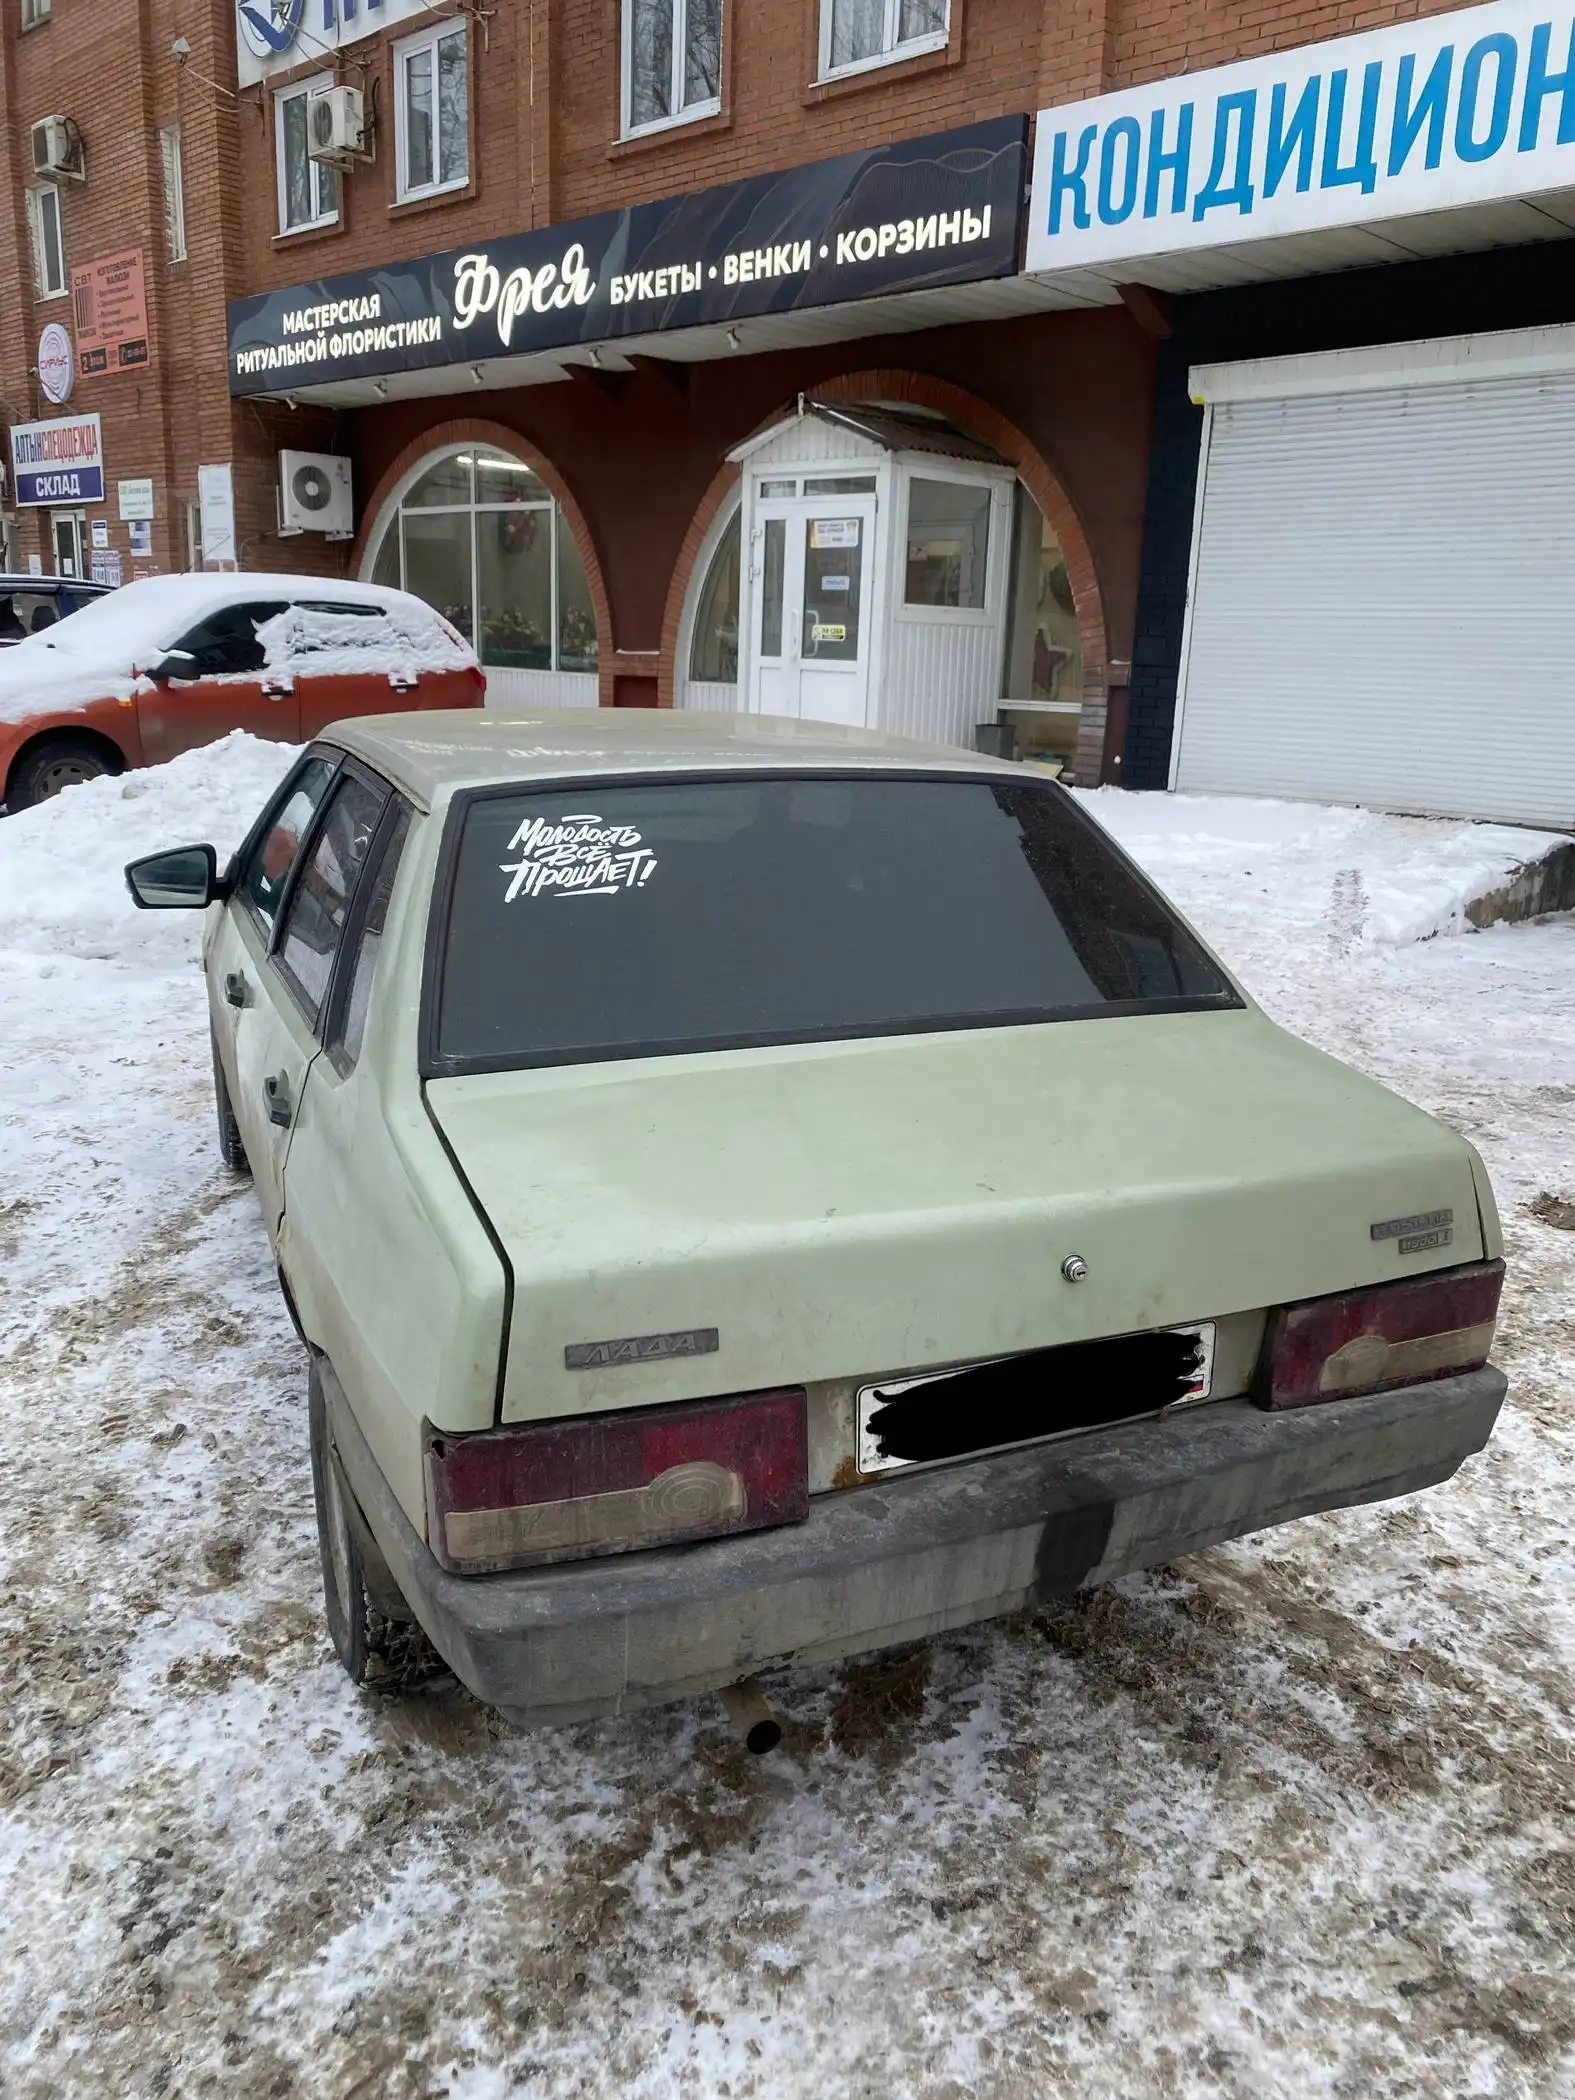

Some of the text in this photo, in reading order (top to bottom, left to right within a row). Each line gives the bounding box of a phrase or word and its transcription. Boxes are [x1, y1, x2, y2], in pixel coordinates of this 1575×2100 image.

[610, 204, 992, 305] БУКЕТЫ ВЕНКИ КОРЗИНЫ
[282, 294, 381, 335] МАСТЕРСКАЯ
[453, 243, 596, 347] Фрея
[236, 316, 441, 374] РИТУАЛЬНОЙ ФЛОРИСТИКИ
[36, 474, 80, 497] СКЛАД
